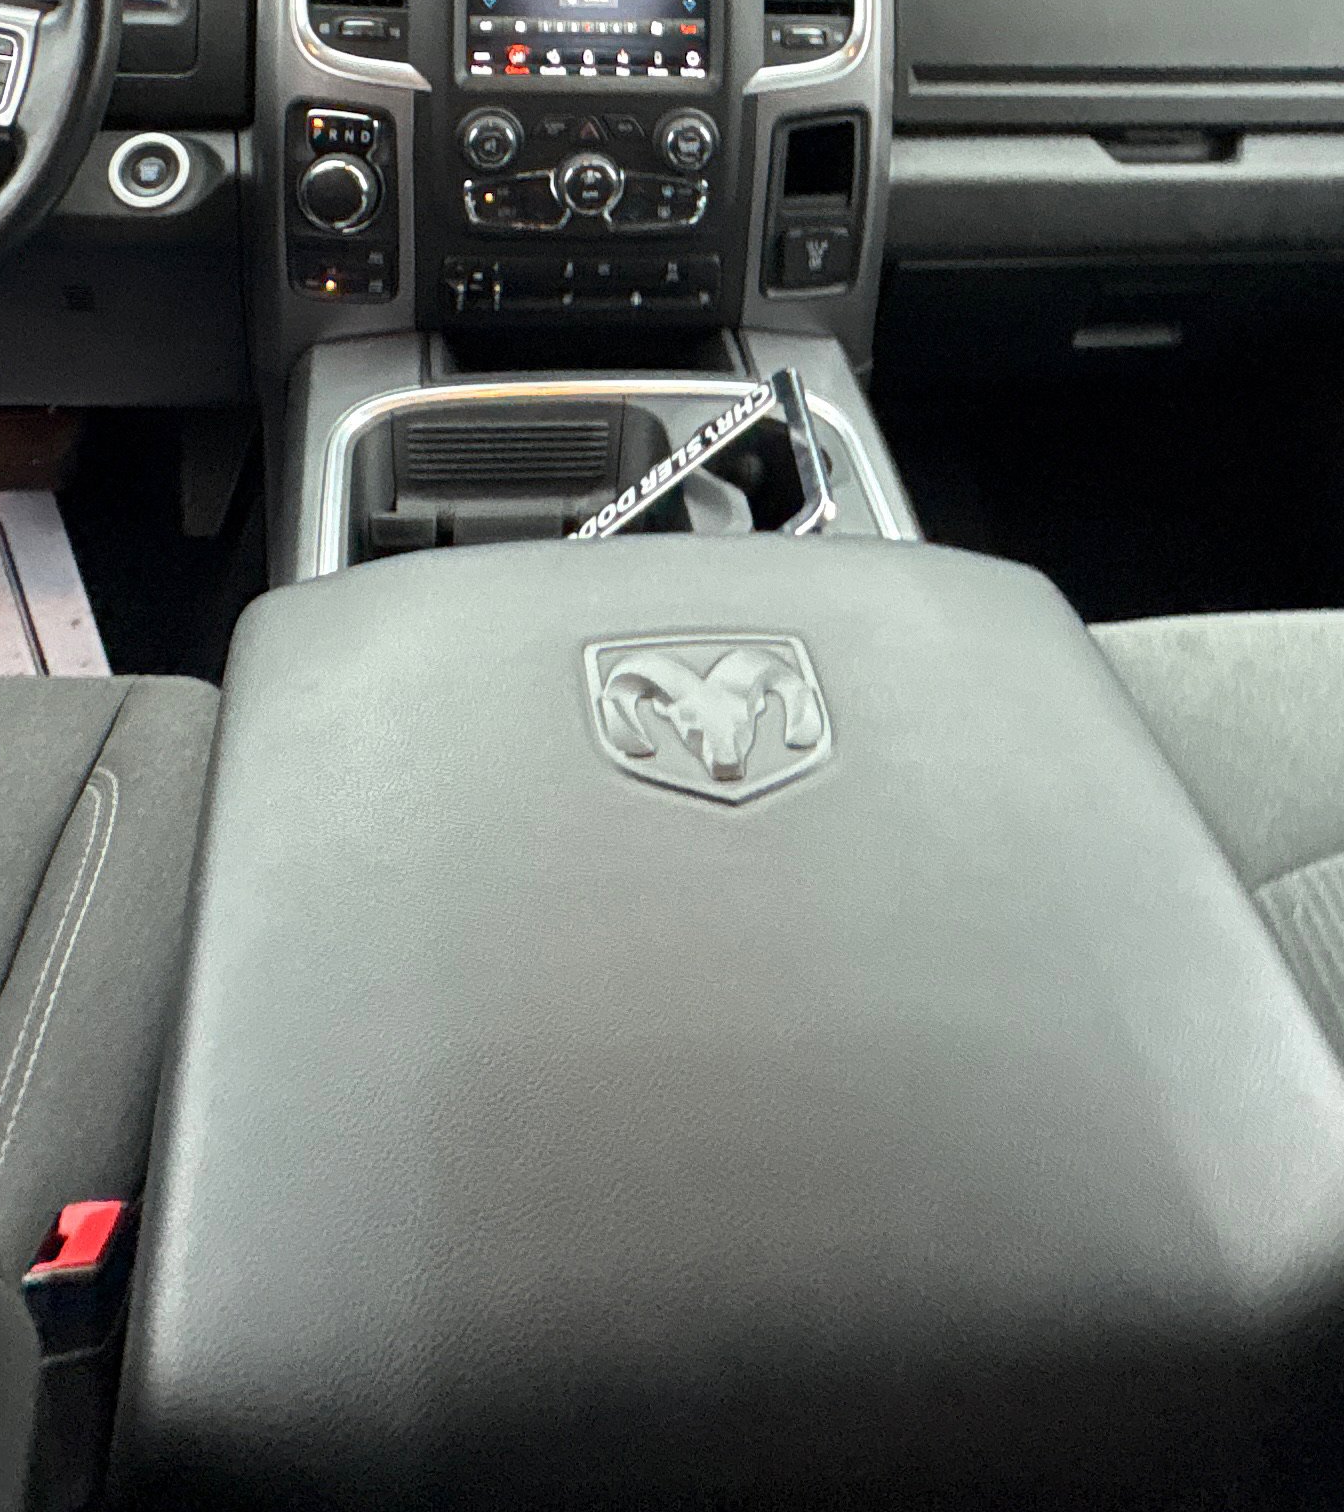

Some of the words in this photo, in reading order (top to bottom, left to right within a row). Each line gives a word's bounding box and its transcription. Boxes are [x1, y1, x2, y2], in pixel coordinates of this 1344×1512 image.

[328, 128, 338, 142] R
[344, 129, 355, 144] N
[360, 129, 371, 144] D
[639, 384, 771, 496] CHRYSLER
[568, 485, 636, 539] DOD
